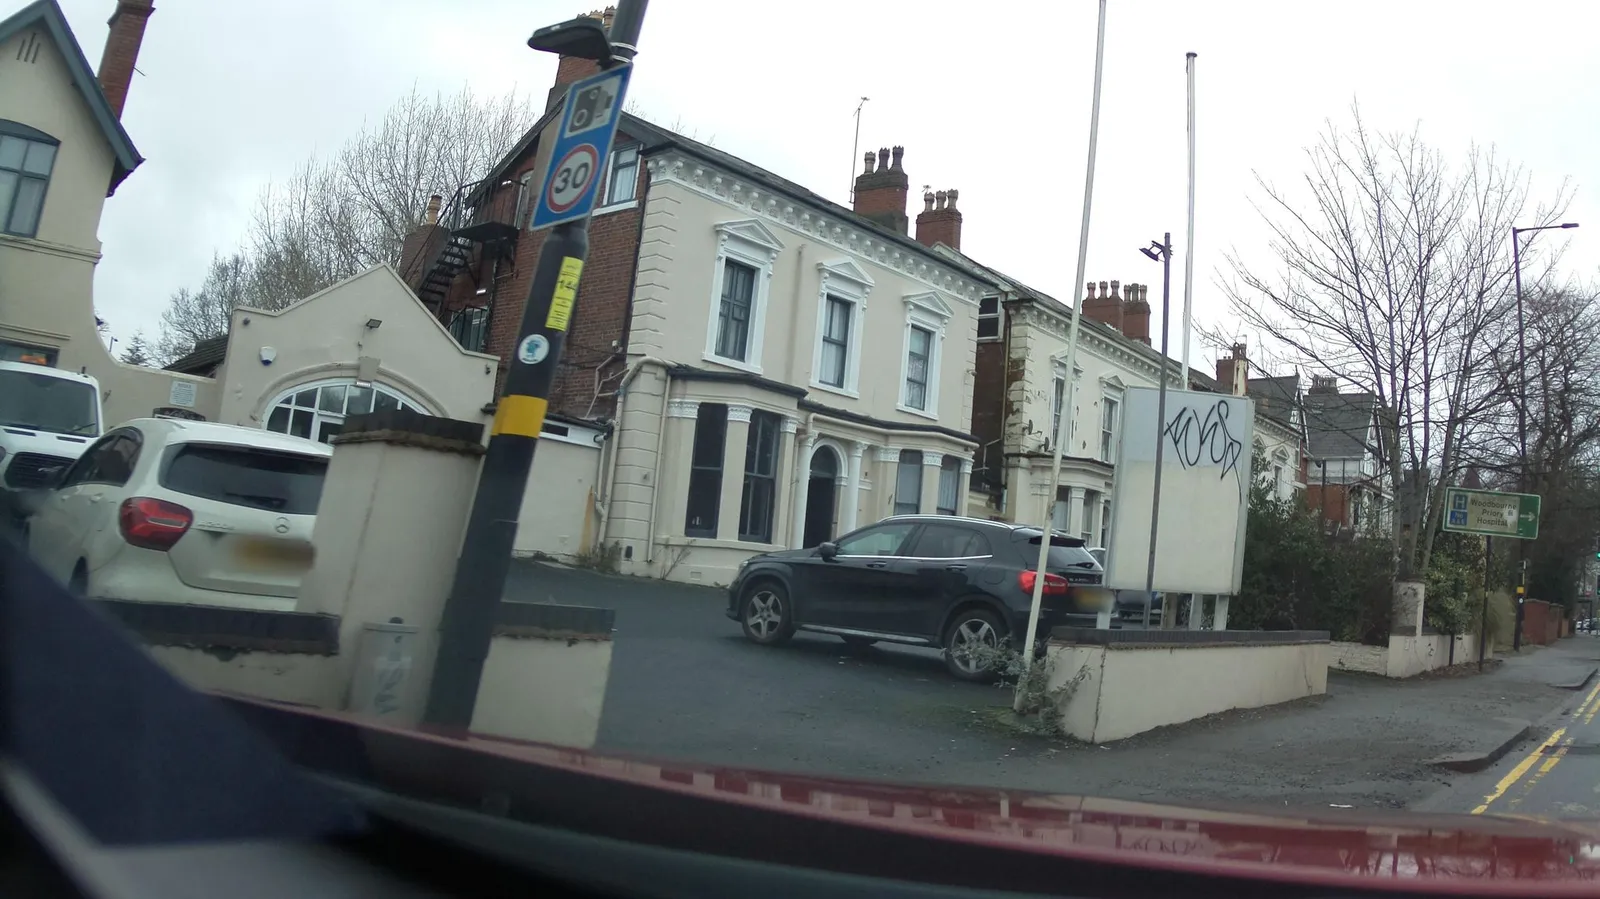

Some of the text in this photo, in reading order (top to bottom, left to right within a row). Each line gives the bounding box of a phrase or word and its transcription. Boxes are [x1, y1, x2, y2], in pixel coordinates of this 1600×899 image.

[554, 162, 590, 194] 30
[1471, 498, 1517, 510] Woodbourne
[1481, 508, 1504, 518] Priory
[1477, 516, 1509, 527] Hospital
